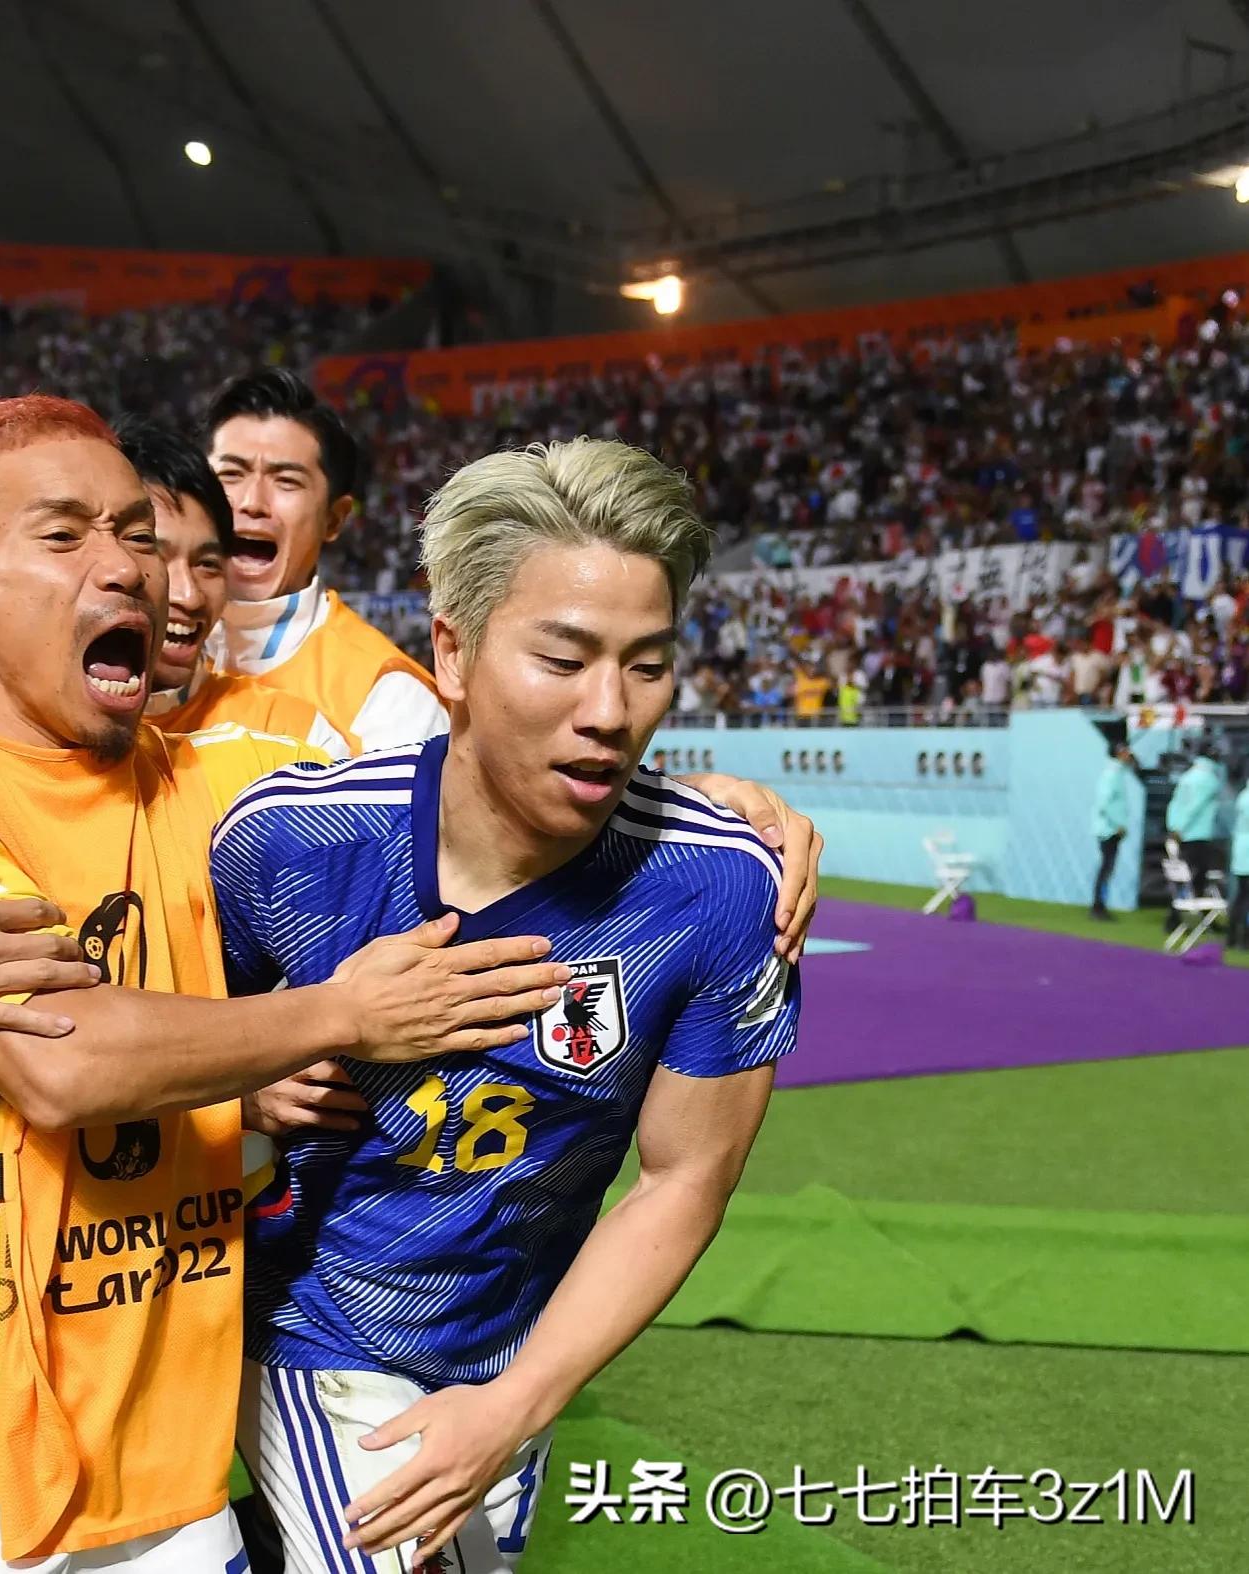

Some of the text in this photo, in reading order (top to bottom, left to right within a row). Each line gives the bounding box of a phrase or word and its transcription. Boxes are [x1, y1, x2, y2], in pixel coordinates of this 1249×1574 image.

[563, 1040, 603, 1059] JFA
[396, 1074, 536, 1174] 18
[176, 1188, 243, 1232] CUP
[497, 1447, 547, 1553] 1
